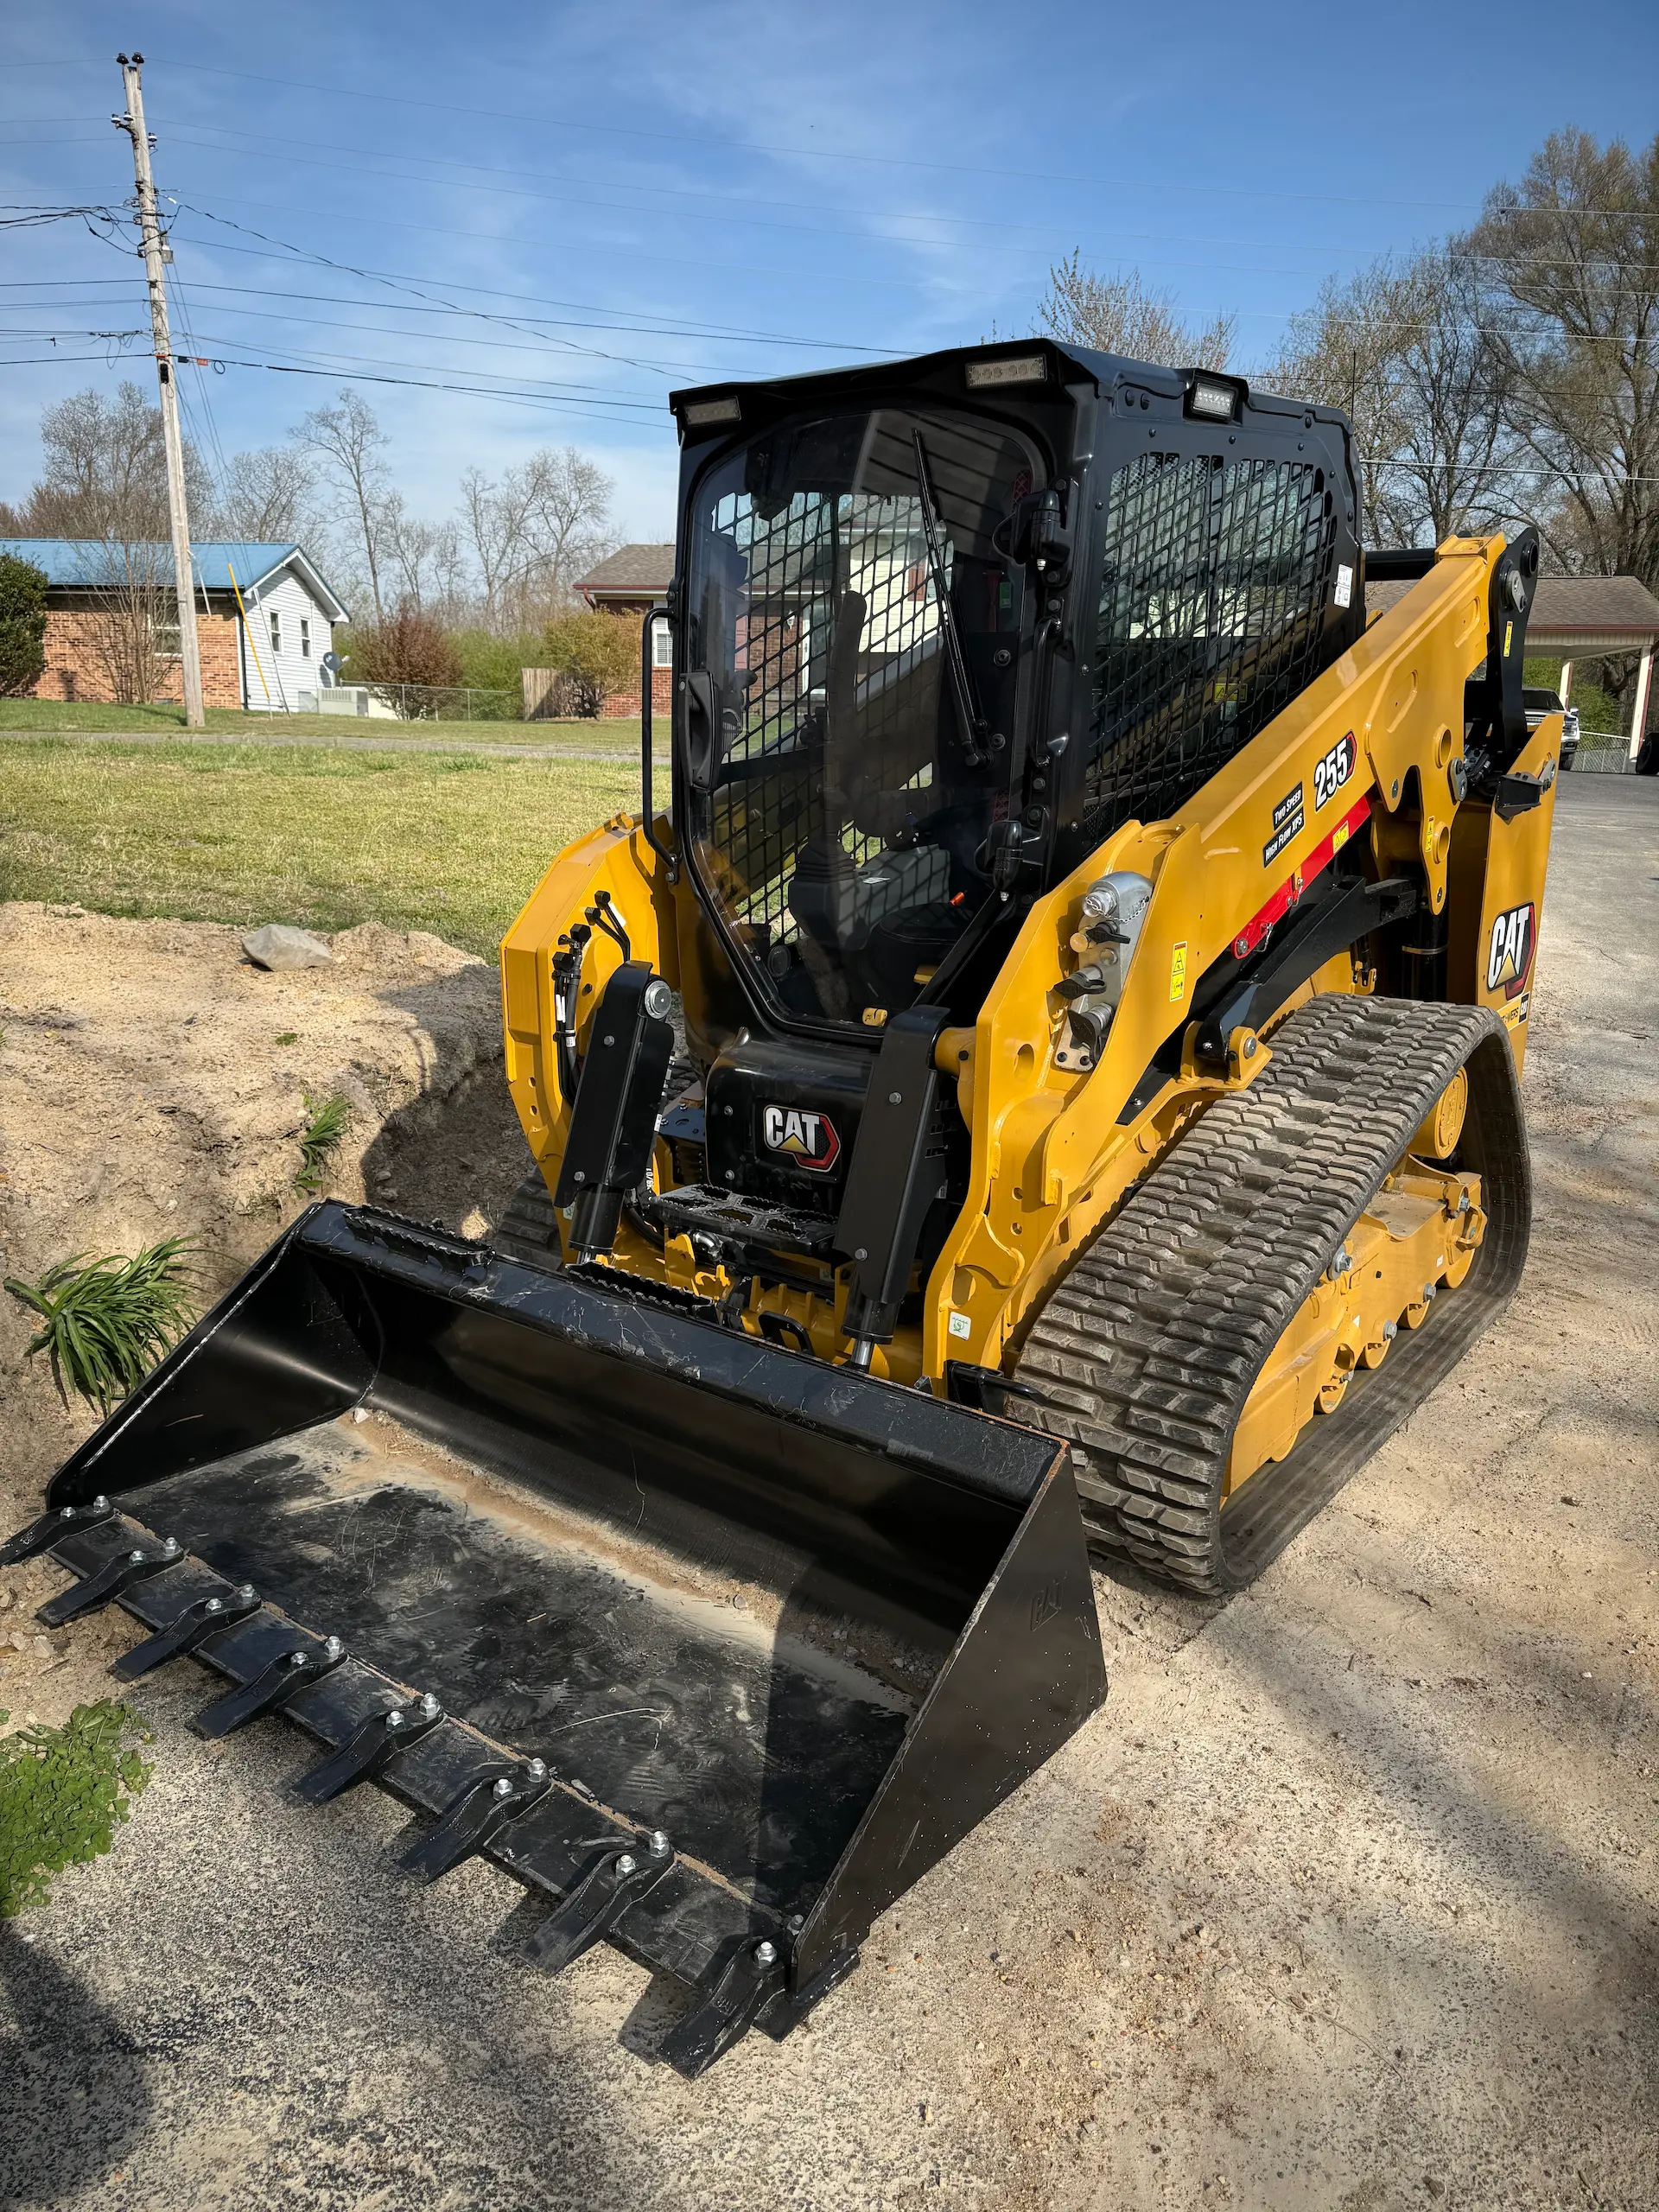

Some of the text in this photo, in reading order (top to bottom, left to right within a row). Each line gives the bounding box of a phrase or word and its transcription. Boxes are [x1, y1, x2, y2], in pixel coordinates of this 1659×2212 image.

[1315, 738, 1348, 808] 255
[1292, 812, 1303, 831] XPS
[1487, 905, 1530, 988] CAT
[1520, 1000, 1529, 1015] CAT
[766, 1107, 820, 1156] CAT
